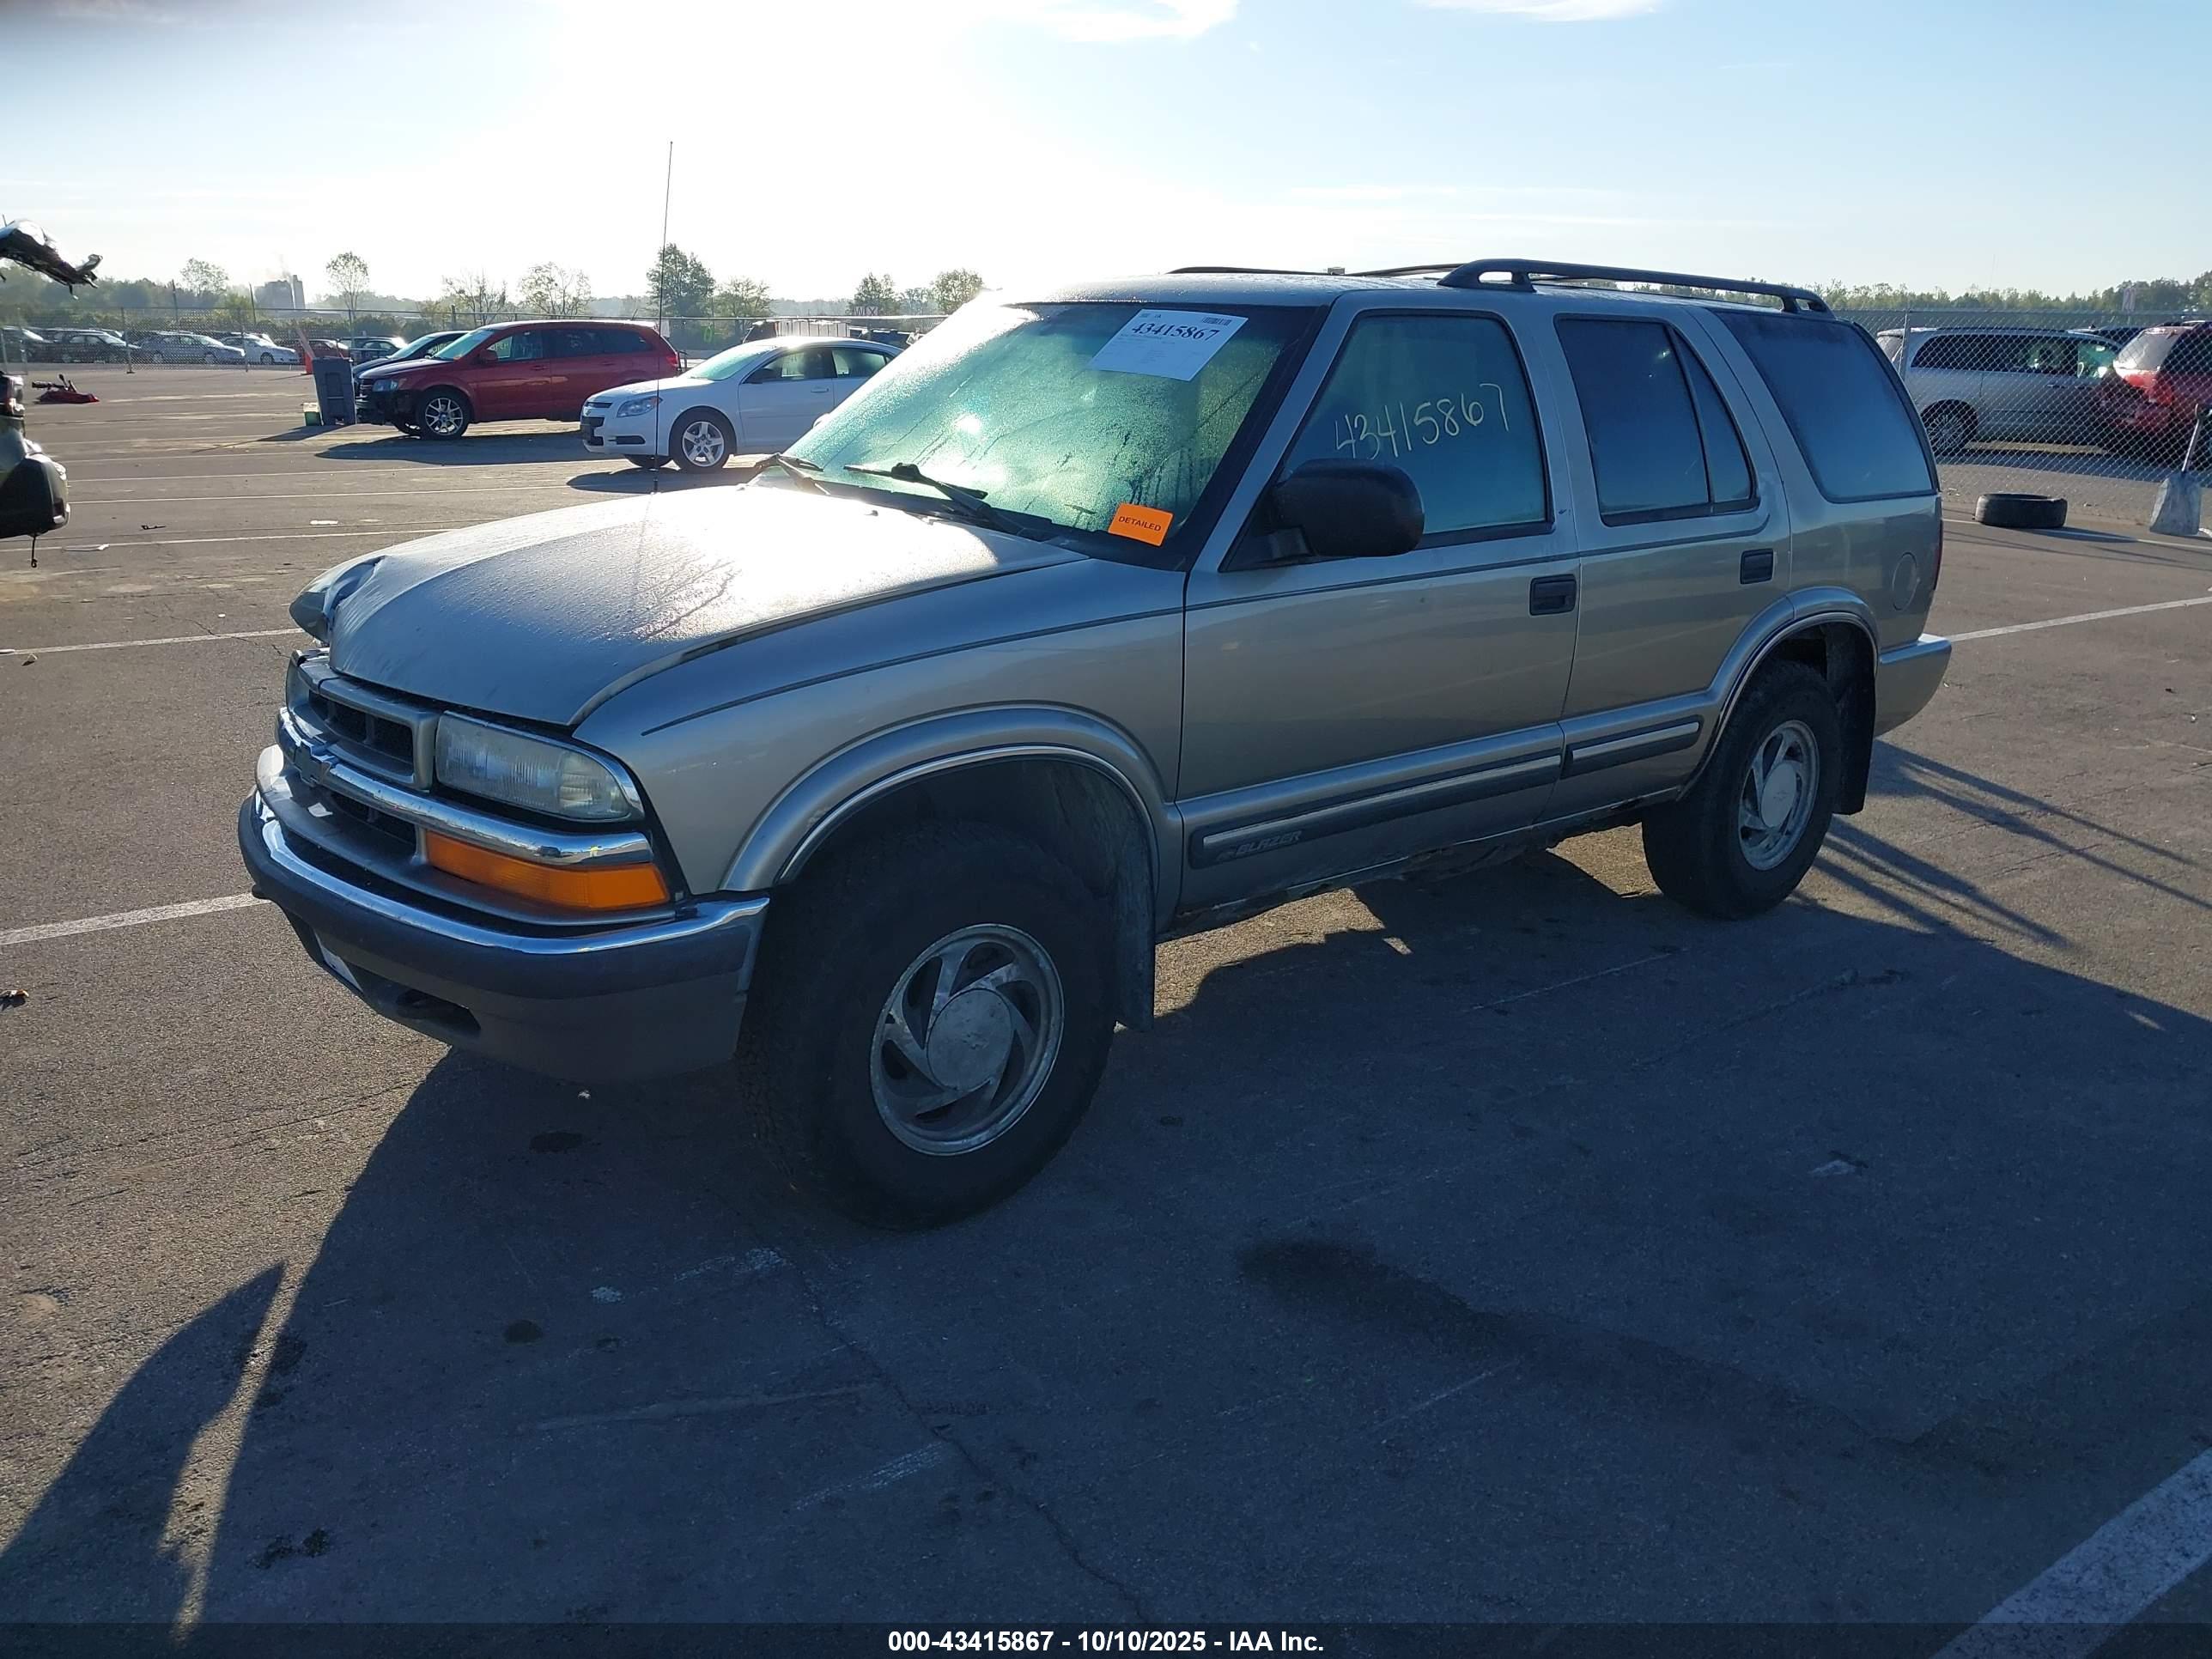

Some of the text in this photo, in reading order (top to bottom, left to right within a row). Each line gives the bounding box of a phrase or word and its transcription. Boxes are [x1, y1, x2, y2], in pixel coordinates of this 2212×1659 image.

[1132, 322, 1220, 342] 43415867
[1334, 383, 1510, 460] 43415867
[1118, 516, 1162, 532] DETAILED
